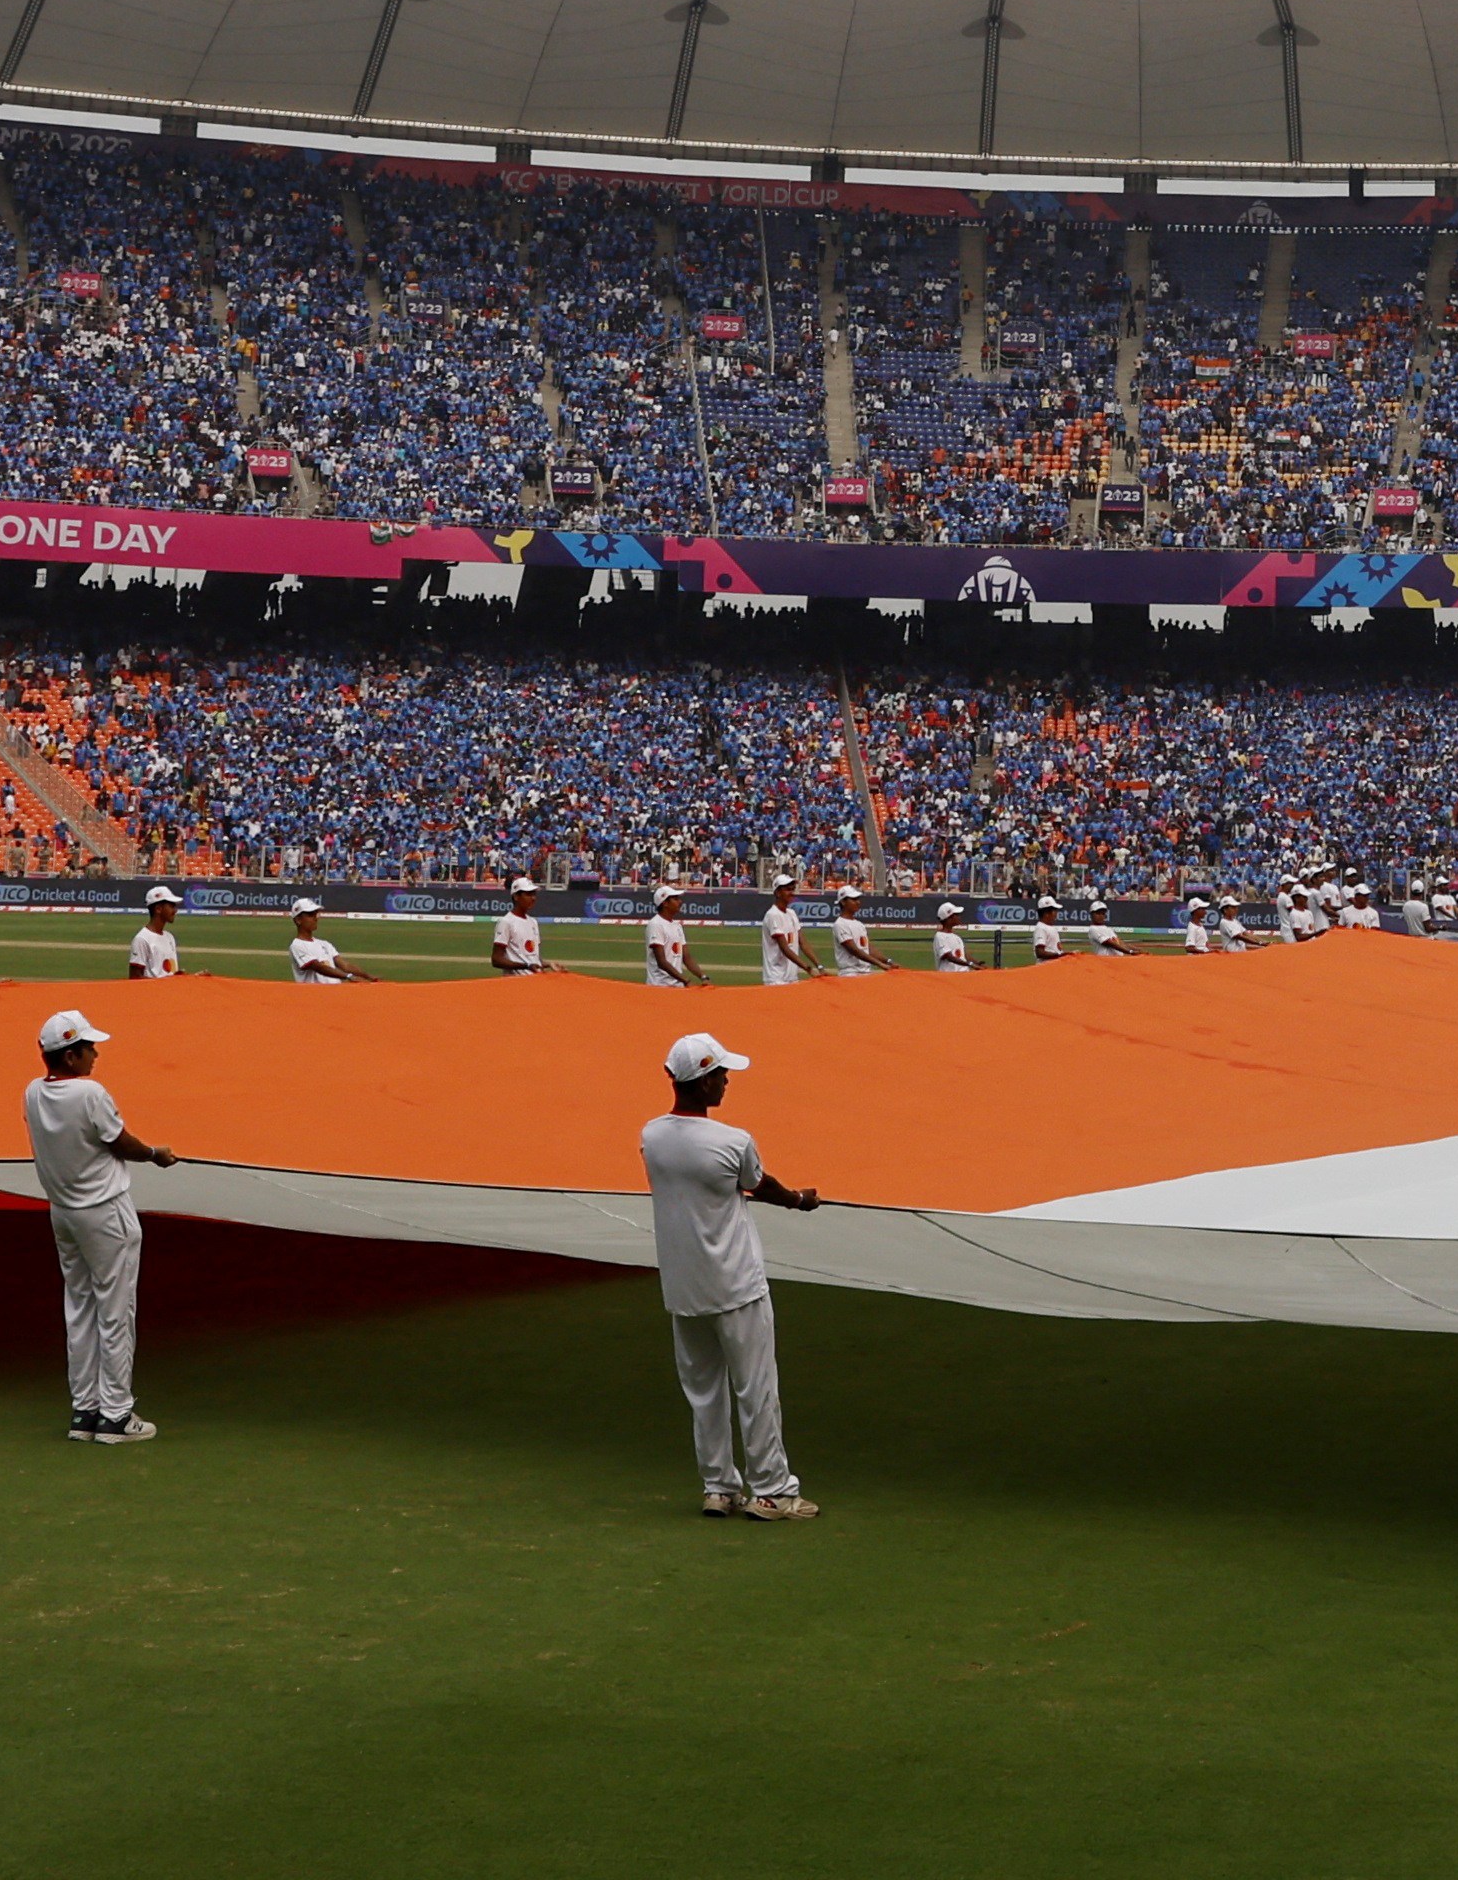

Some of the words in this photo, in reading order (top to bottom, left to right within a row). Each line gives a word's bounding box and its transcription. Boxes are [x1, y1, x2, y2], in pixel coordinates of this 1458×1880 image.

[500, 171, 533, 189] ICC
[708, 184, 788, 203] WORLD
[794, 187, 839, 205] CUP
[93, 522, 178, 555] DAY
[3, 887, 27, 900] ICC
[32, 888, 76, 902] Cricket
[77, 889, 87, 902] 4
[88, 889, 120, 903] Good
[207, 892, 231, 905] ICC
[235, 893, 280, 906] Cricket
[409, 896, 432, 909] ICC
[437, 898, 480, 911] Cricket
[608, 901, 631, 914] ICC
[690, 903, 720, 916] Good
[806, 905, 827, 917] ICC
[885, 907, 916, 919] Good
[999, 908, 1021, 920] ICC
